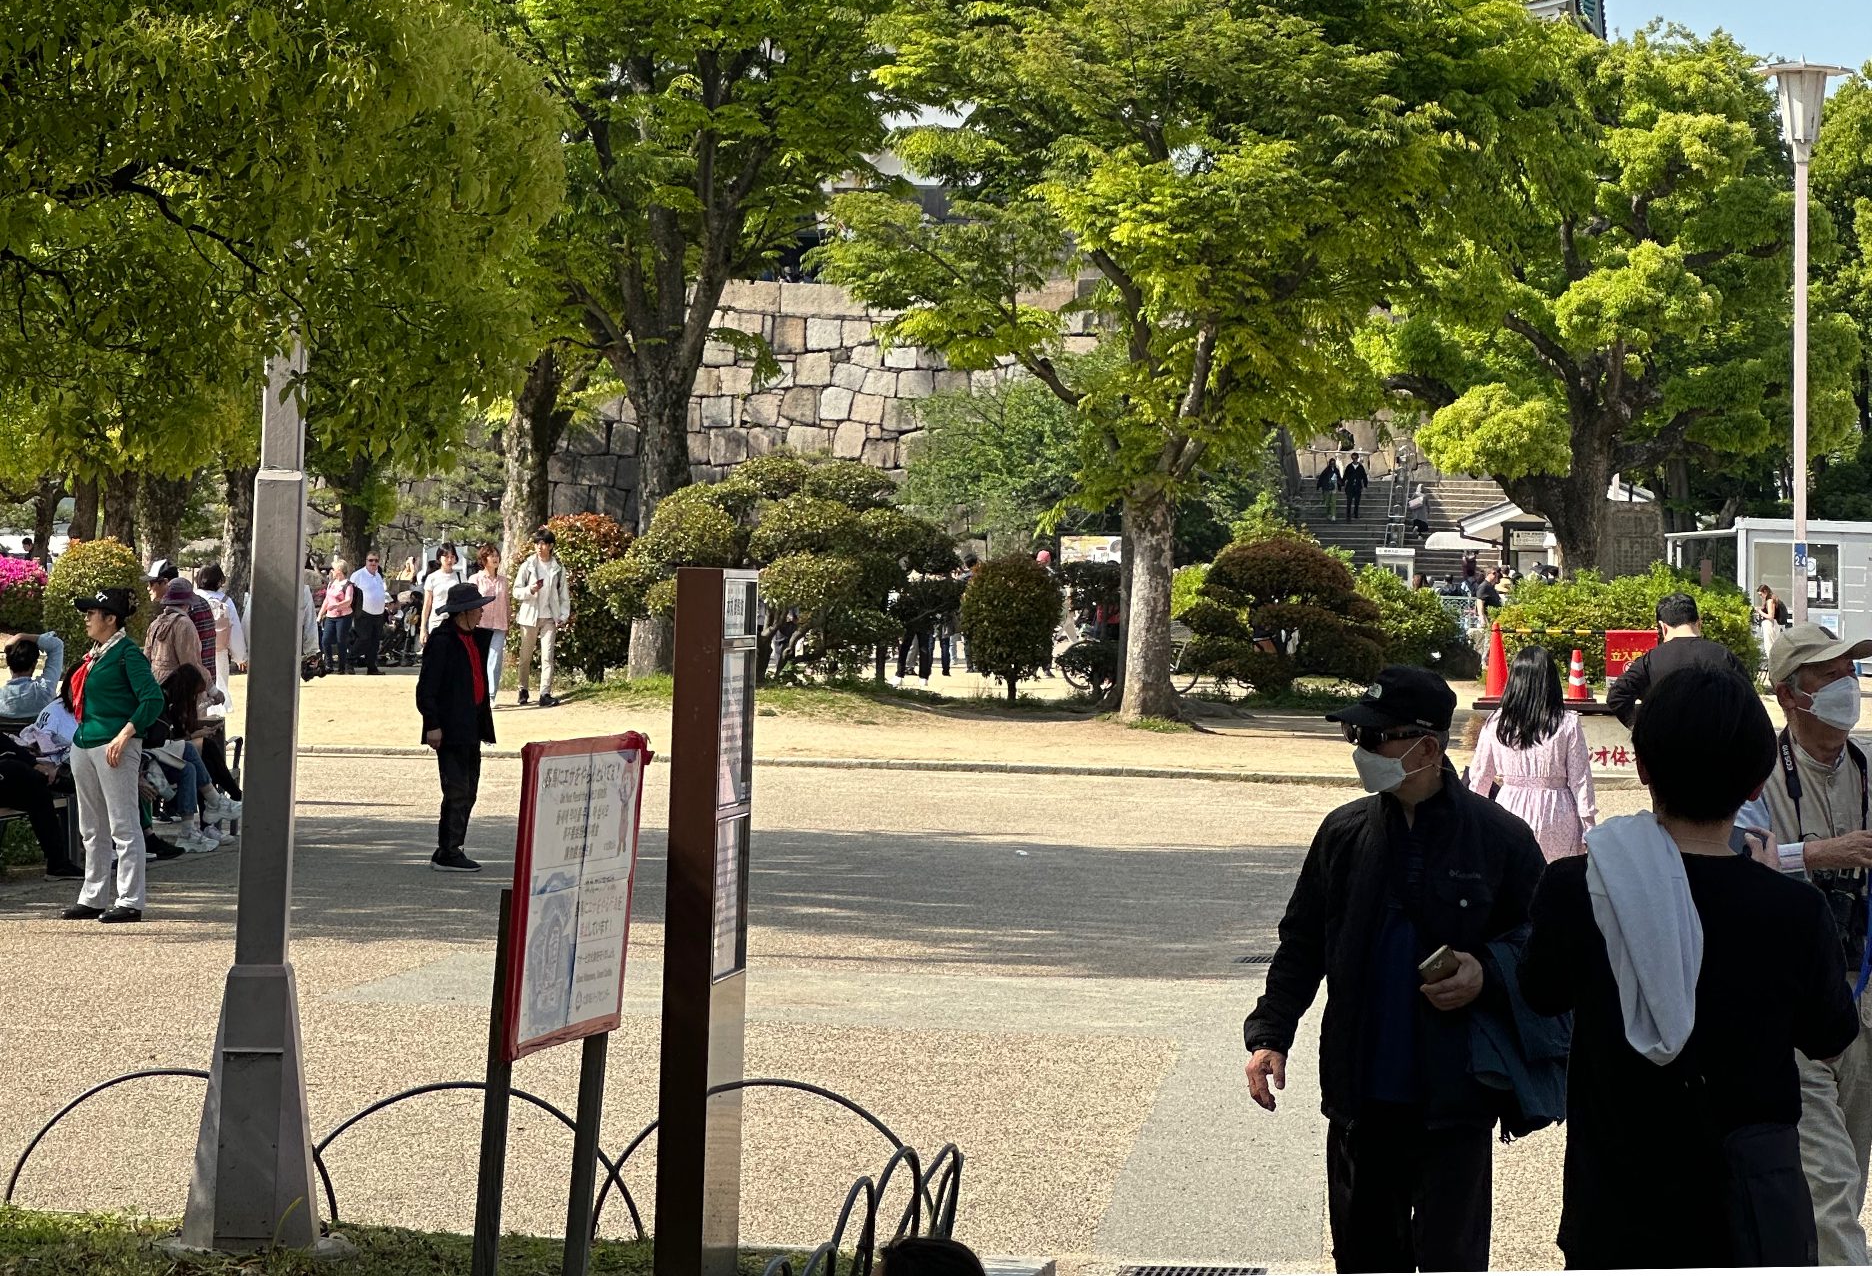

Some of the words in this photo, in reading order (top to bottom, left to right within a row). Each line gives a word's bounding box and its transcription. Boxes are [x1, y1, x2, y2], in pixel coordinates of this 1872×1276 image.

[1795, 556, 1806, 566] 24
[1611, 651, 1646, 661] 立入禁
[1589, 745, 1637, 767] オ体
[1785, 756, 1793, 771] EOS
